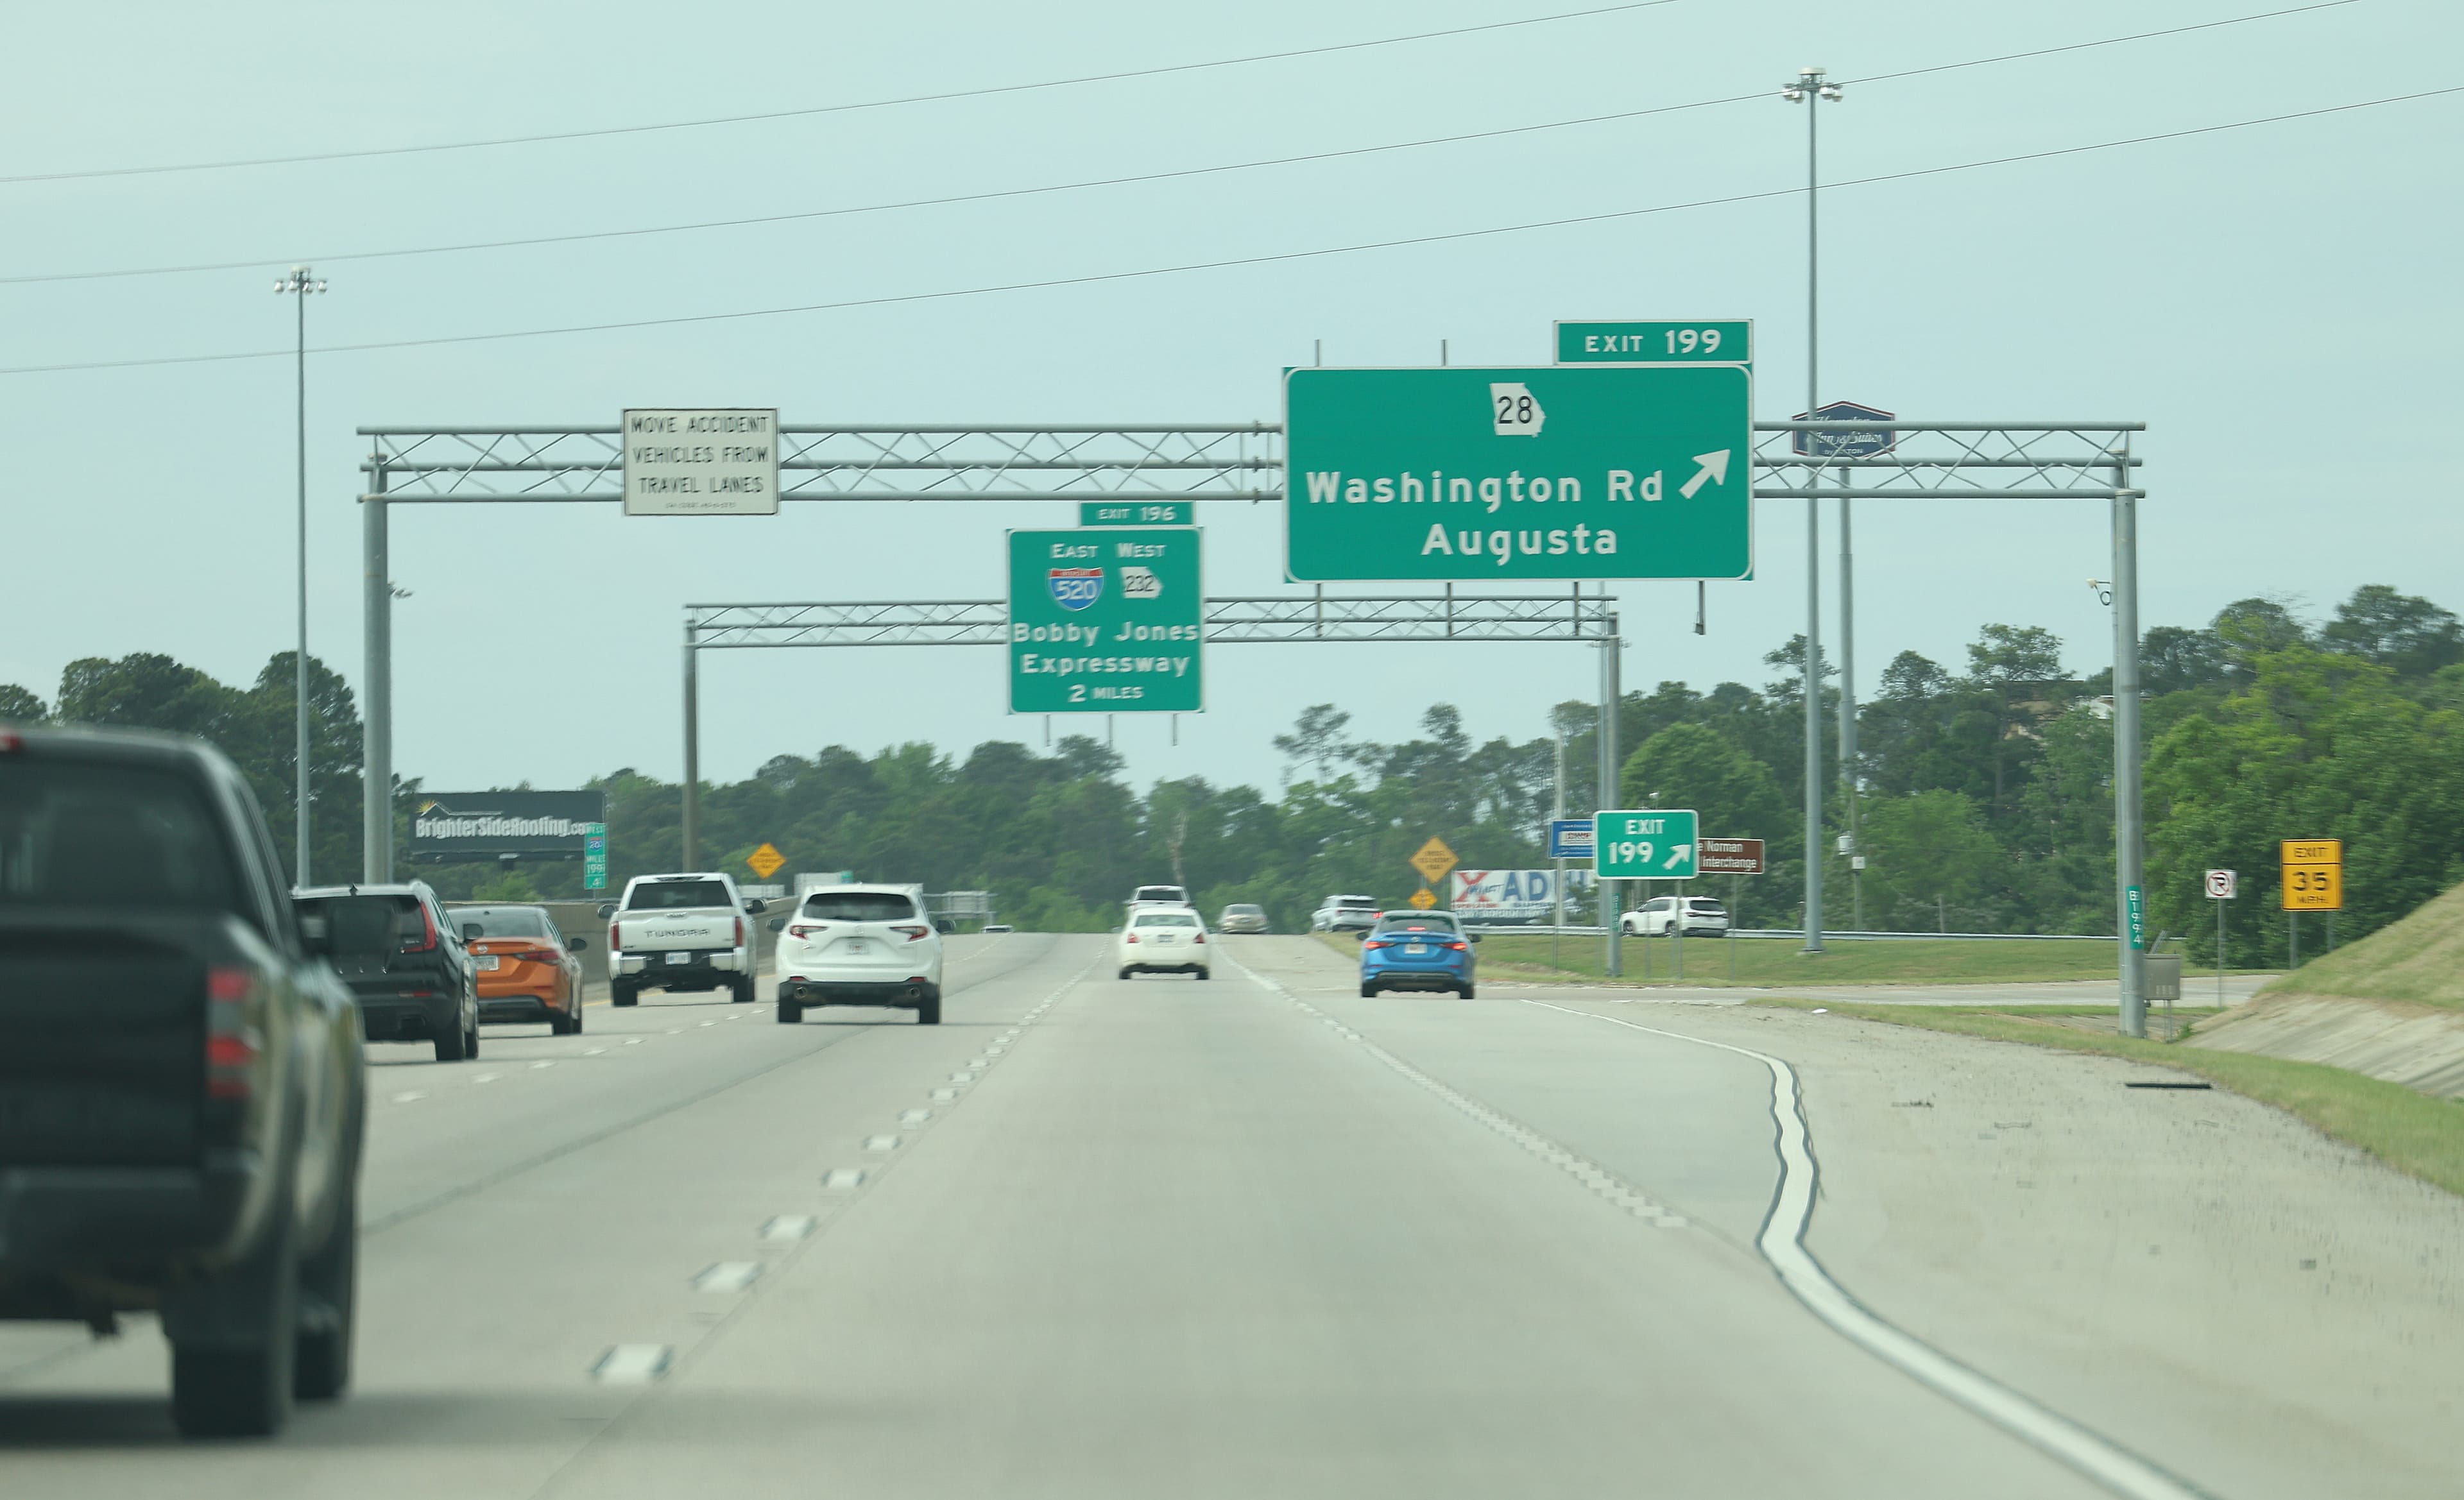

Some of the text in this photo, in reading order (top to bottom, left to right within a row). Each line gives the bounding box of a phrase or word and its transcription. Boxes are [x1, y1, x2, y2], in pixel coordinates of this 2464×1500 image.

[1584, 329, 1722, 354] EXIT 199
[1497, 395, 1532, 424] 28
[631, 416, 769, 433] MOVE ACCIDENT
[633, 446, 769, 463] VEHICLES FROM
[638, 476, 764, 494] TRAVEL LANES
[1306, 469, 1664, 514] Washington Rd
[1098, 506, 1176, 521] EXIT 196
[1050, 542, 1167, 558] EAST WEST
[1420, 522, 1618, 567] Augusta
[1056, 579, 1097, 600] 520
[1125, 575, 1156, 592] 232
[1012, 621, 1199, 647] Bobby Jones
[1020, 653, 1191, 678] Expressway
[1068, 684, 1145, 703] 2 MILES
[416, 815, 590, 839] BrighterSideRoofing.co
[1625, 819, 1665, 835] EXIT
[1608, 841, 1654, 864] 199
[1704, 840, 1743, 853] Norman
[2294, 847, 2330, 857] EXIT
[1700, 856, 1757, 872] Interchange
[2291, 871, 2331, 891] 35
[644, 928, 711, 938] TUNDRA
